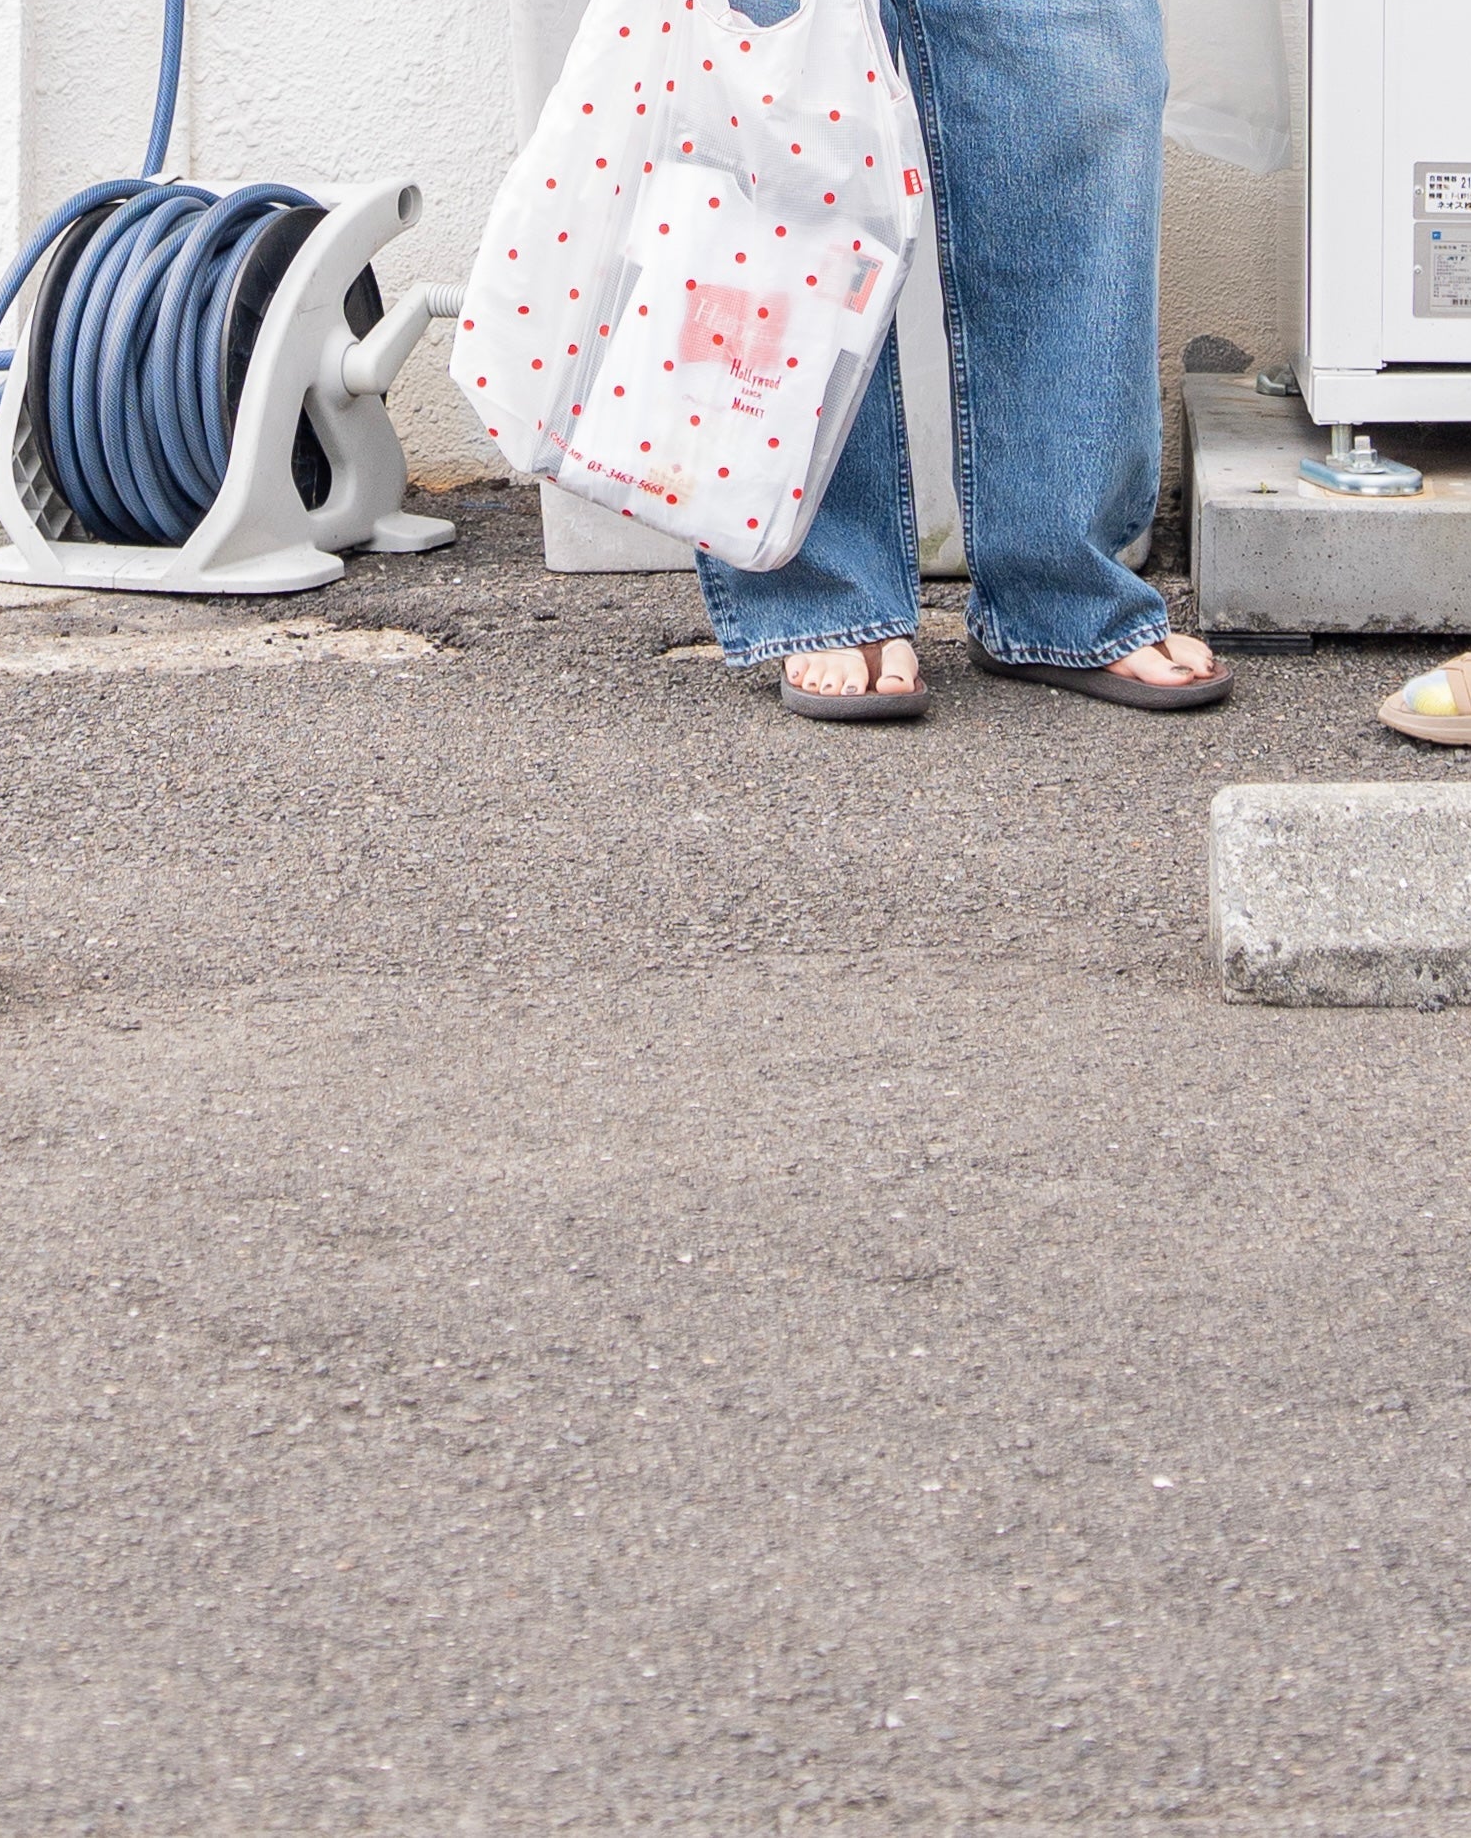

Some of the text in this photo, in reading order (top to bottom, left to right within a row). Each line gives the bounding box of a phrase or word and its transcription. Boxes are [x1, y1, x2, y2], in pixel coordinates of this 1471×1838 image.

[731, 358, 782, 391] Hollywood
[731, 397, 765, 420] MARKET
[587, 460, 665, 496] 03-3463-5668
